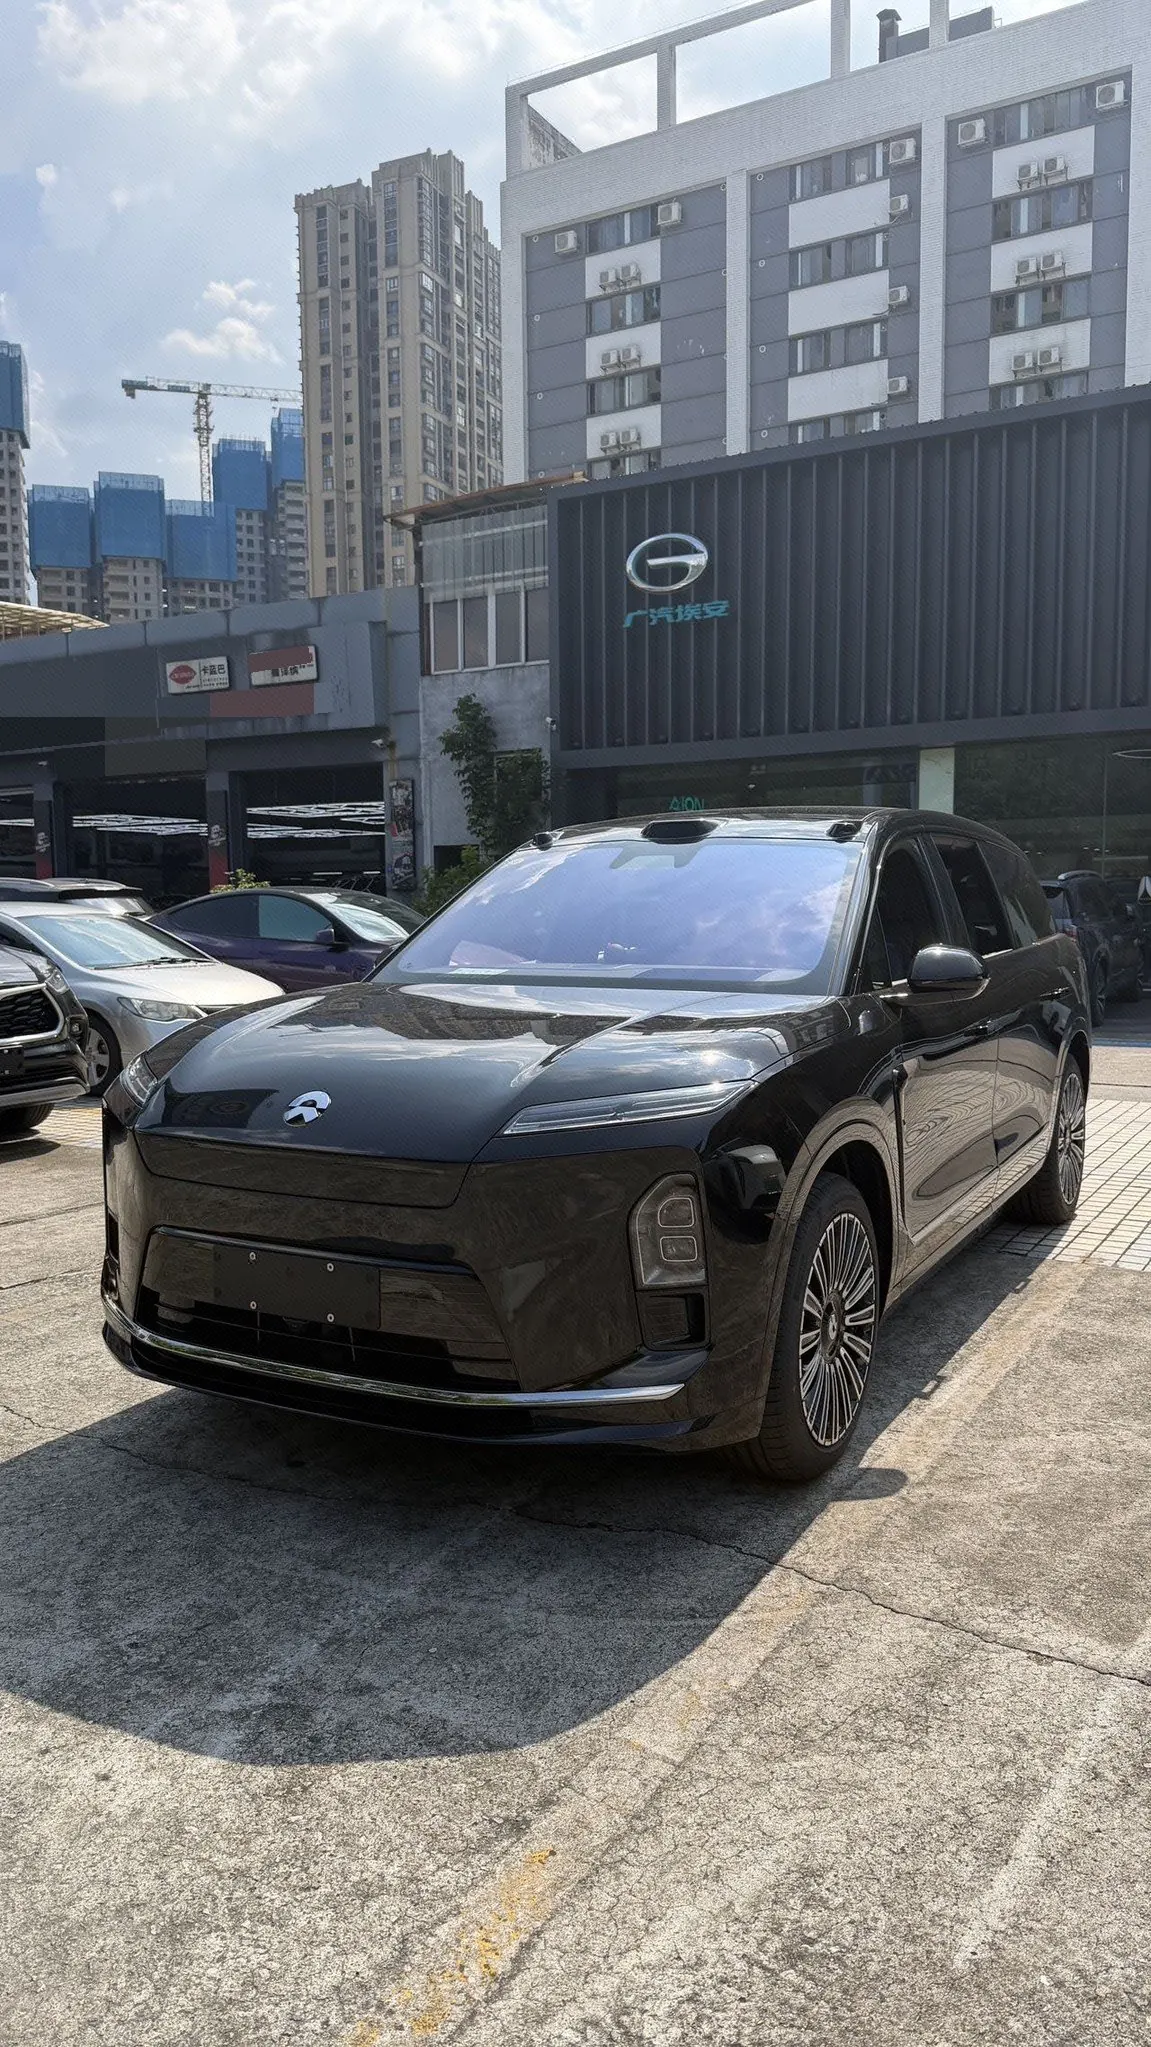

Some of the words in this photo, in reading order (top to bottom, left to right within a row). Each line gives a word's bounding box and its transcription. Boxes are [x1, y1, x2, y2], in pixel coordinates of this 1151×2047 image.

[623, 600, 729, 628] 广汽埃安
[669, 796, 705, 811] AION
